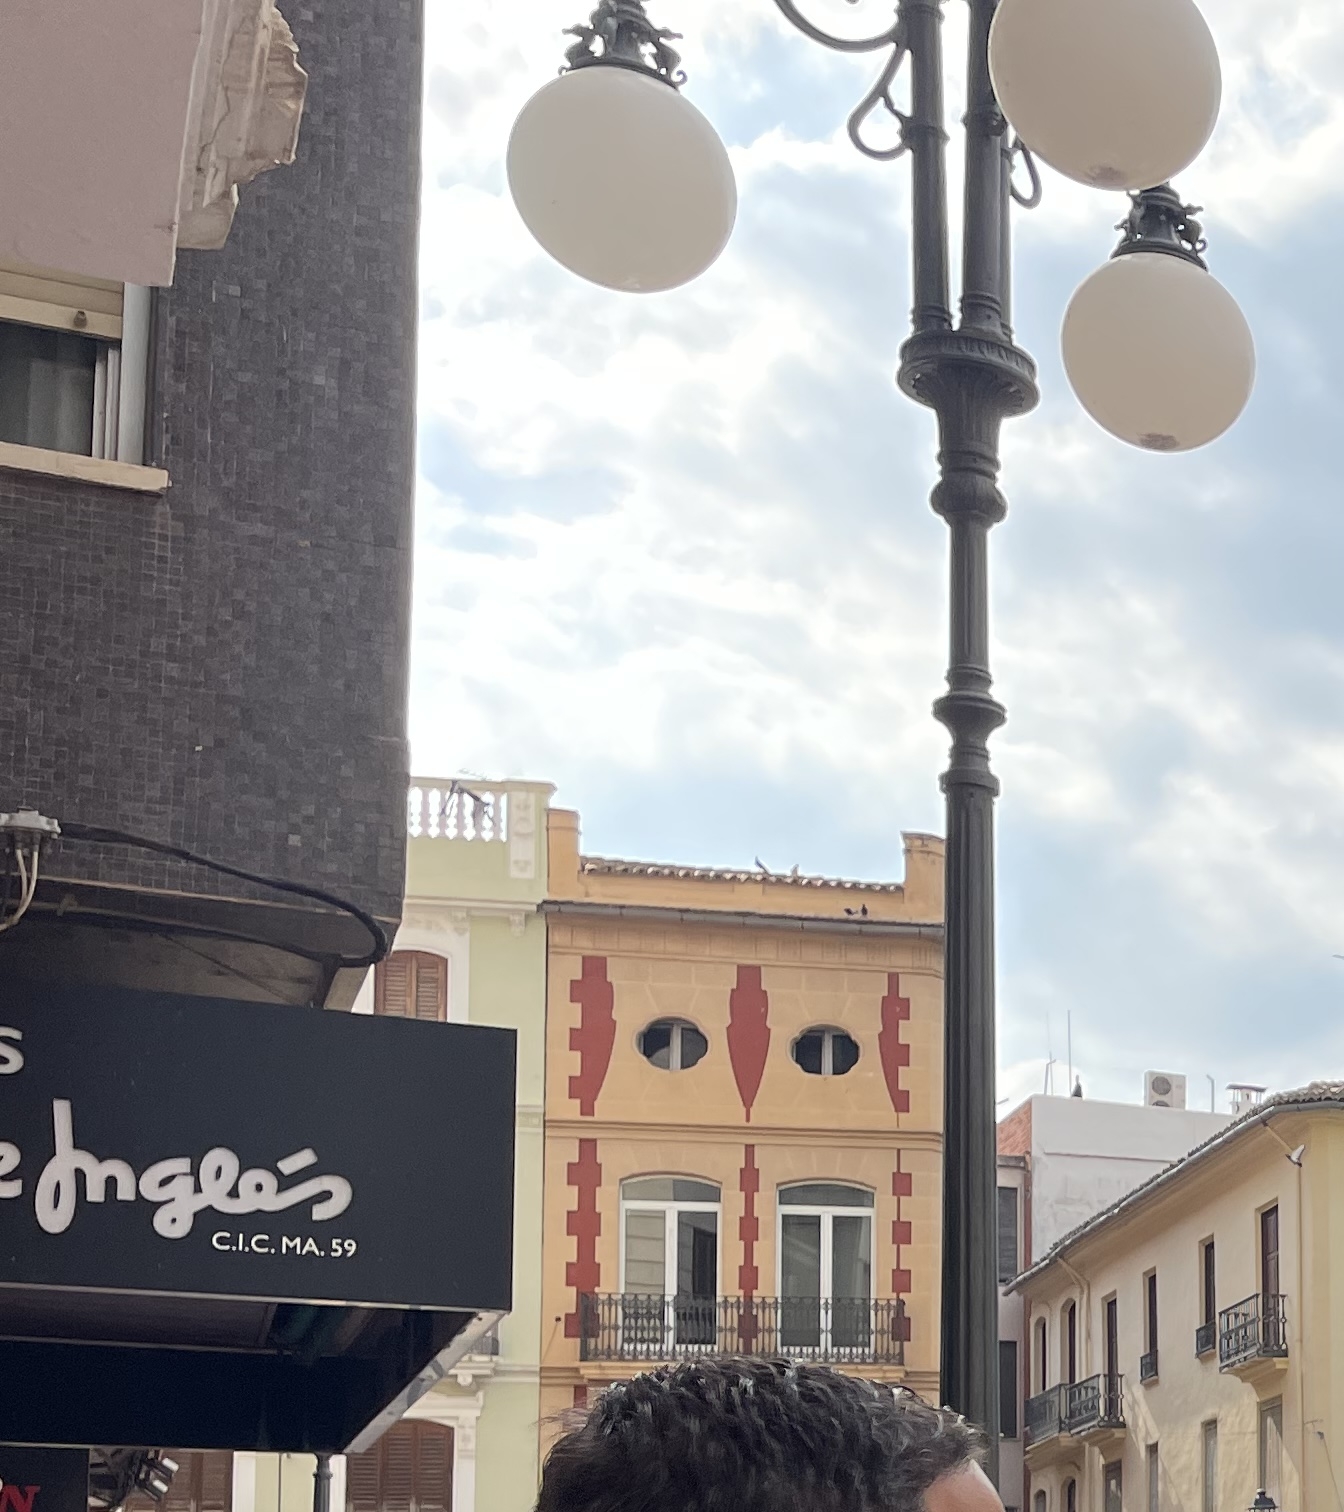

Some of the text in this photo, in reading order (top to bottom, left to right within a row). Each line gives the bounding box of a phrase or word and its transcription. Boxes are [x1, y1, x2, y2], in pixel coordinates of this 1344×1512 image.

[211, 1231, 357, 1258] C.I.C. MA. 59
